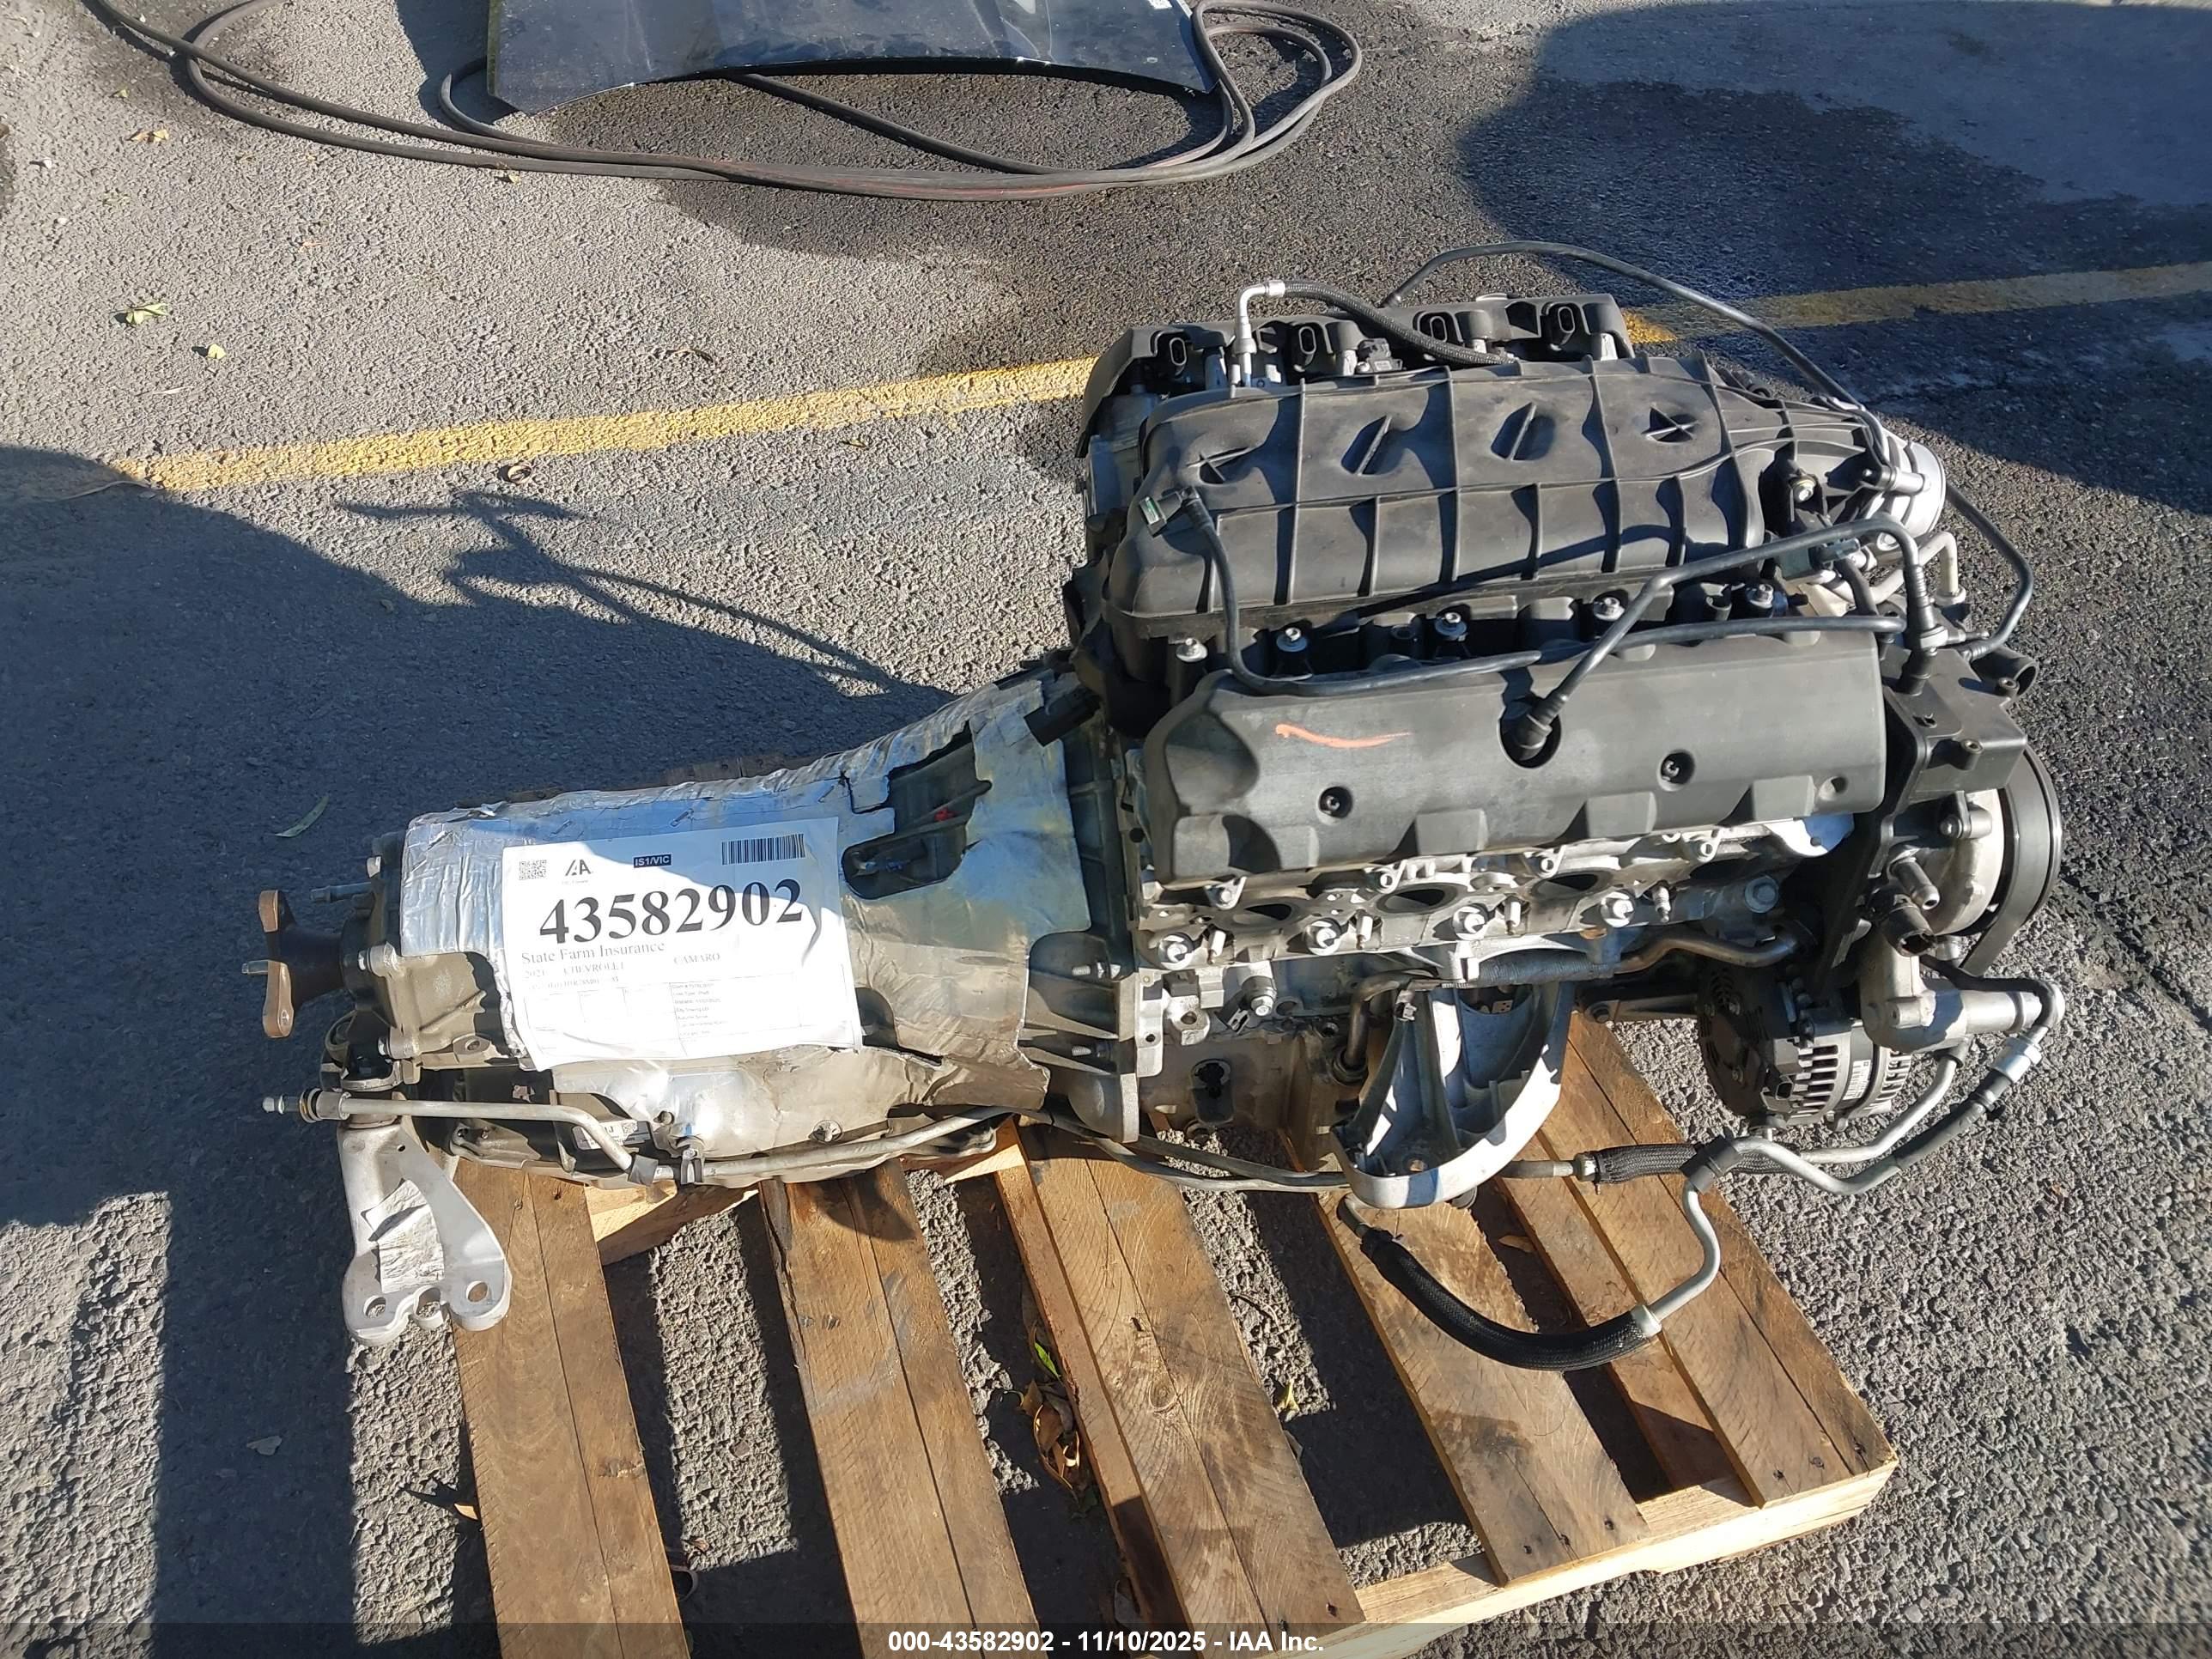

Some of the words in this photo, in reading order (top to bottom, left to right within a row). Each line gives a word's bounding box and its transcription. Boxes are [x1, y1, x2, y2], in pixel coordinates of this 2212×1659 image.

[635, 855, 670, 866] IS1/VIC
[539, 878, 803, 944] 43582902
[521, 951, 556, 963] State
[559, 947, 596, 960] Farm
[599, 942, 665, 957] Insurance
[673, 952, 721, 964] CAMARO
